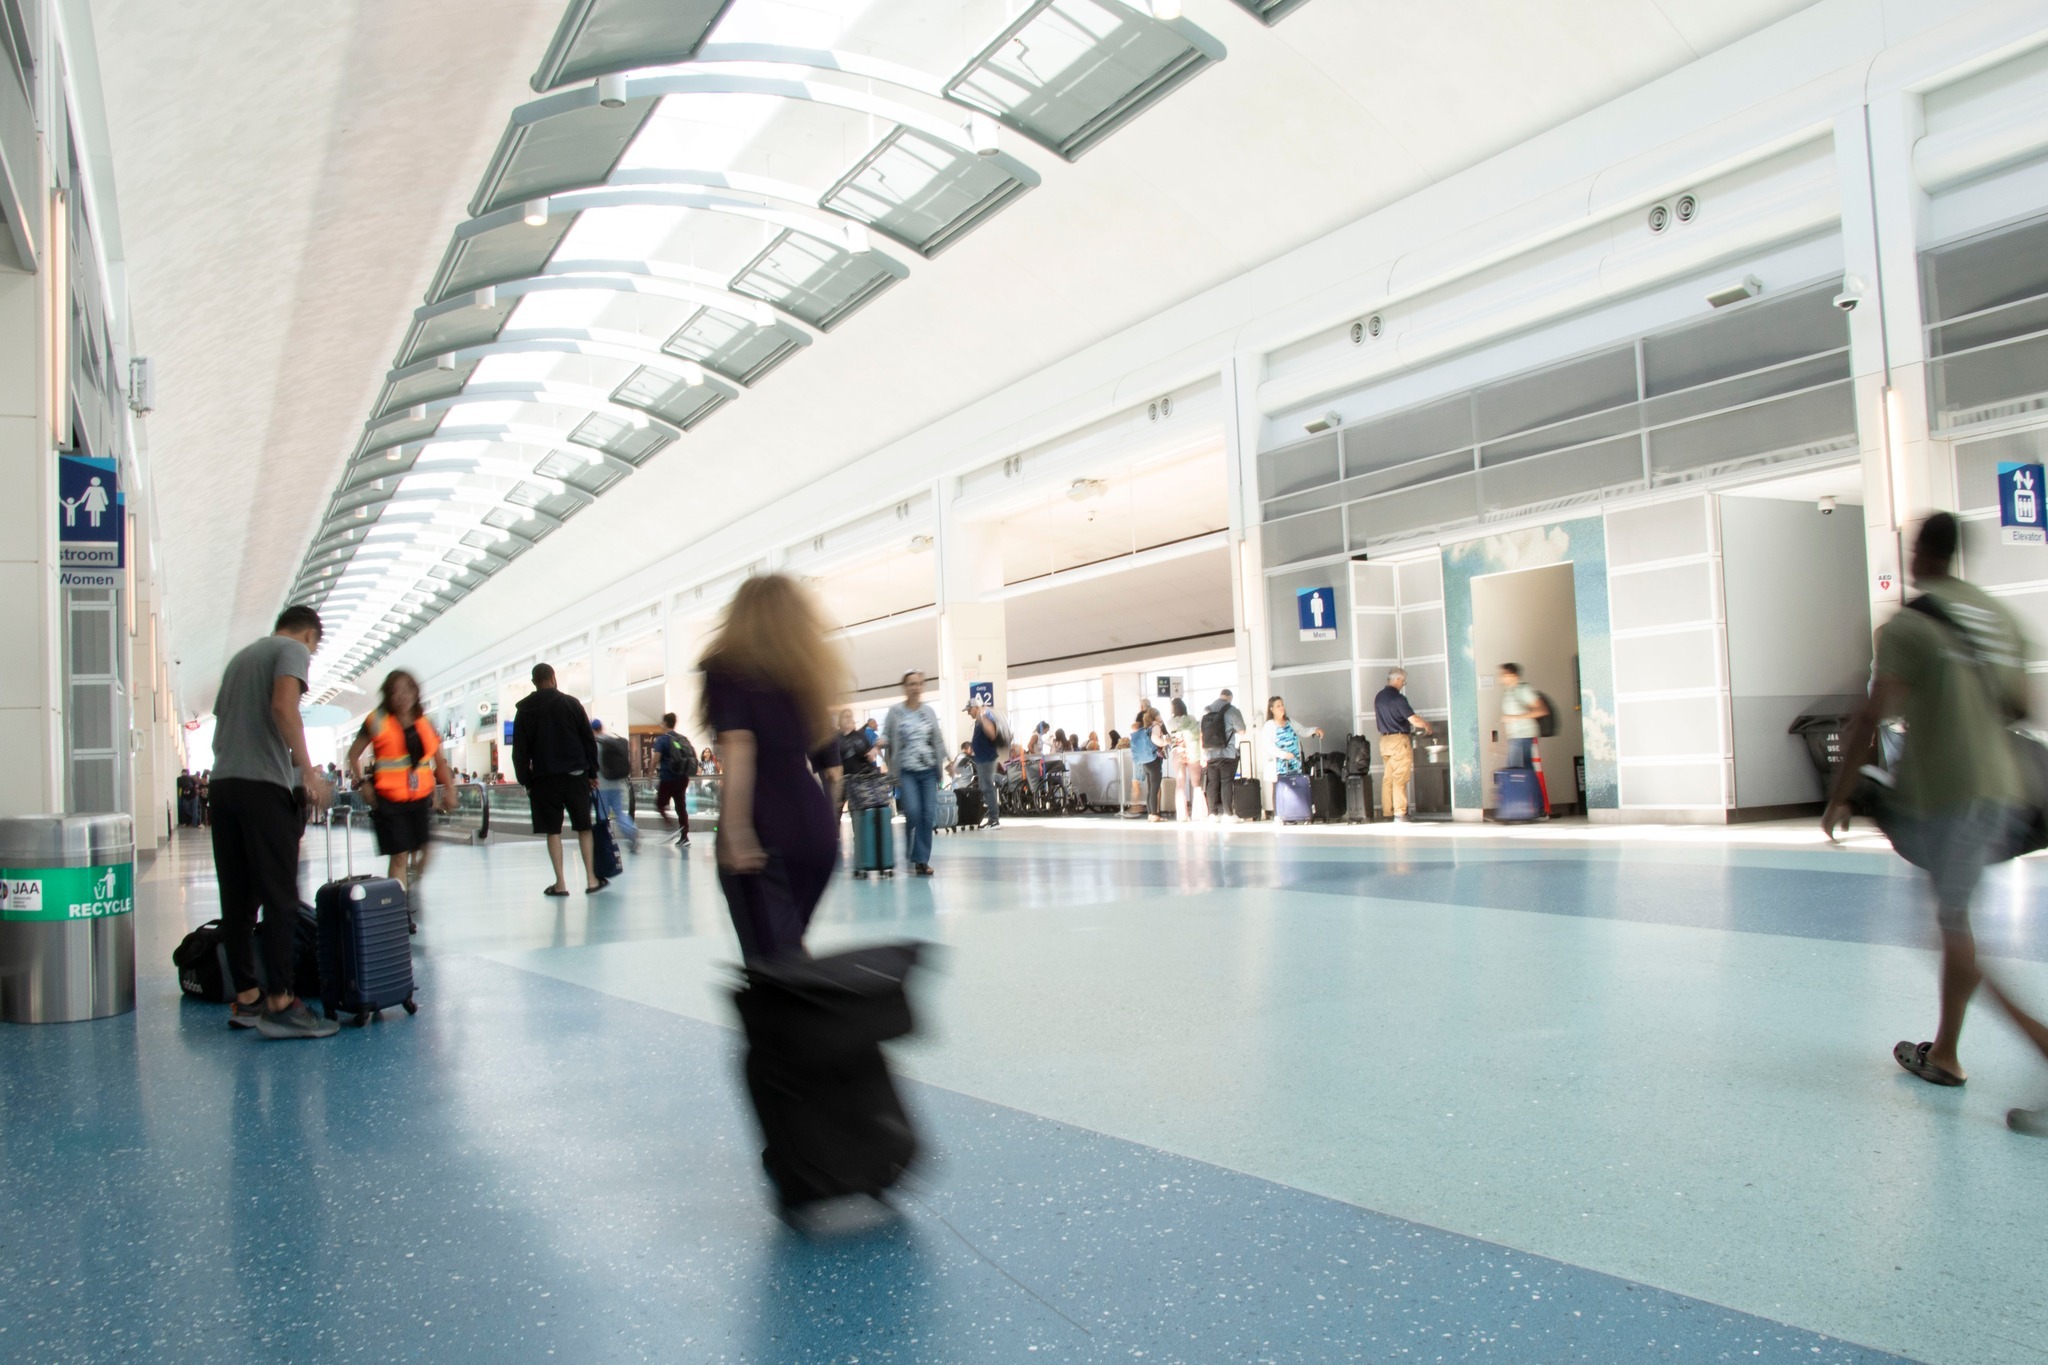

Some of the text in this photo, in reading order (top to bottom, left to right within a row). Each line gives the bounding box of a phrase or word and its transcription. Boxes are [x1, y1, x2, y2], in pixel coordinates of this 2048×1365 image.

[2012, 530, 2042, 541] Elevator
[60, 573, 114, 585] Women
[974, 692, 993, 706] A2
[1826, 733, 1840, 741] JAA
[13, 882, 40, 894] JAA
[69, 897, 132, 918] RECYCLE
